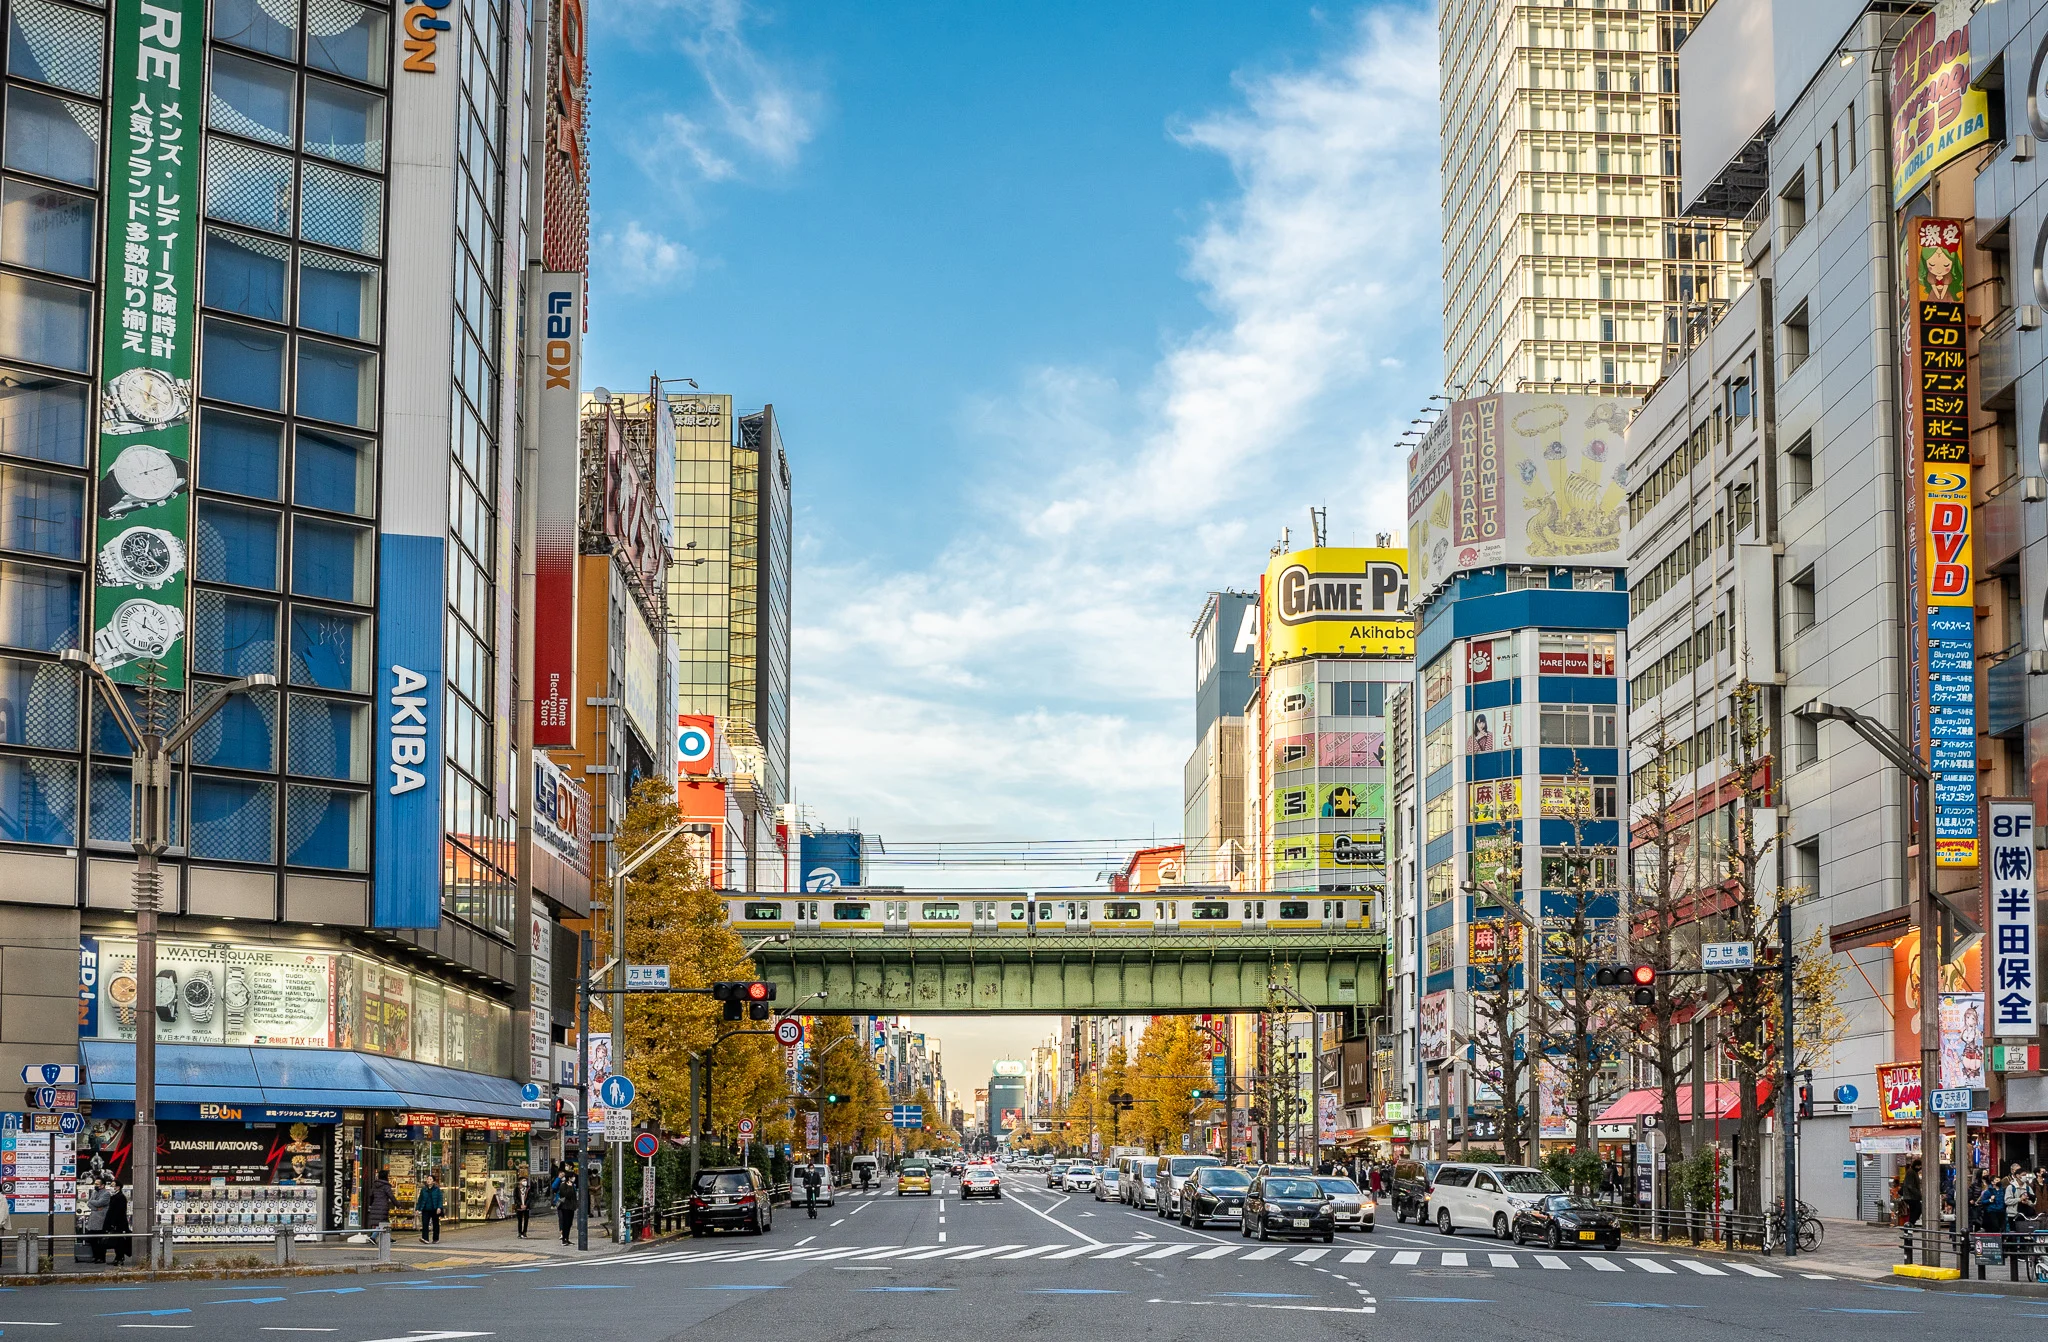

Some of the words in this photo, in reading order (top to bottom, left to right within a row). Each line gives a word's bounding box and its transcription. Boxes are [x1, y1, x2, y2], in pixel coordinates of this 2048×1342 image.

[1904, 142, 1934, 182] WORLD
[1938, 114, 1984, 152] AKIBA
[121, 93, 154, 353] 人気ブランド多数取り揃え
[151, 101, 182, 359] メンズ・レディース腕時計
[1919, 225, 1960, 247] 激安
[1923, 305, 1962, 322] ゲーム
[1928, 328, 1959, 345] CD
[1924, 351, 1964, 368] アイドル
[1924, 374, 1965, 391] アニメ
[1926, 397, 1963, 414] コミック
[1928, 420, 1963, 437] ホビー
[1479, 401, 1495, 500] WELCOME
[1926, 443, 1965, 461] フィギュア
[1410, 455, 1451, 513] TAKARADA
[1462, 414, 1475, 539] AKIHABARA
[1484, 507, 1496, 535] TO
[1930, 502, 1969, 596] DVD
[1282, 568, 1363, 617] GAME
[1927, 607, 1938, 615] 6F
[1931, 621, 1971, 630] イベントスペース
[1929, 640, 1939, 648] 5F
[1931, 660, 1972, 670] インディーズ映像
[1929, 673, 1940, 681] 4F
[550, 673, 560, 726] Electronics
[1932, 693, 1973, 702] インディーズ映像
[559, 698, 568, 727] Home
[1930, 706, 1941, 714] 3F
[389, 665, 427, 795] AKIBA
[1932, 727, 1973, 736] インディーズ映像
[1933, 760, 1974, 769] アイドル写真集
[1476, 783, 1514, 804] 麻雀
[1542, 787, 1564, 798] 麻雀
[1993, 815, 2032, 838] 8F
[167, 947, 217, 958] WATCH
[220, 950, 273, 962] SQUARE
[1707, 946, 1748, 957] 万世橋
[630, 969, 666, 979] 万世橋
[781, 1026, 797, 1039] 50
[290, 1037, 305, 1046] TAX
[309, 1037, 325, 1047] FREE
[1892, 1068, 1909, 1083] DVD
[44, 1090, 54, 1103] 17
[56, 1092, 75, 1101] 中央通り
[1945, 1092, 1967, 1102] 中央通り
[200, 1104, 242, 1120] EDION
[304, 1110, 337, 1118] エディオン
[35, 1116, 58, 1125] 中央通り
[61, 1118, 76, 1129] 437
[170, 1141, 214, 1150] TAMASHII
